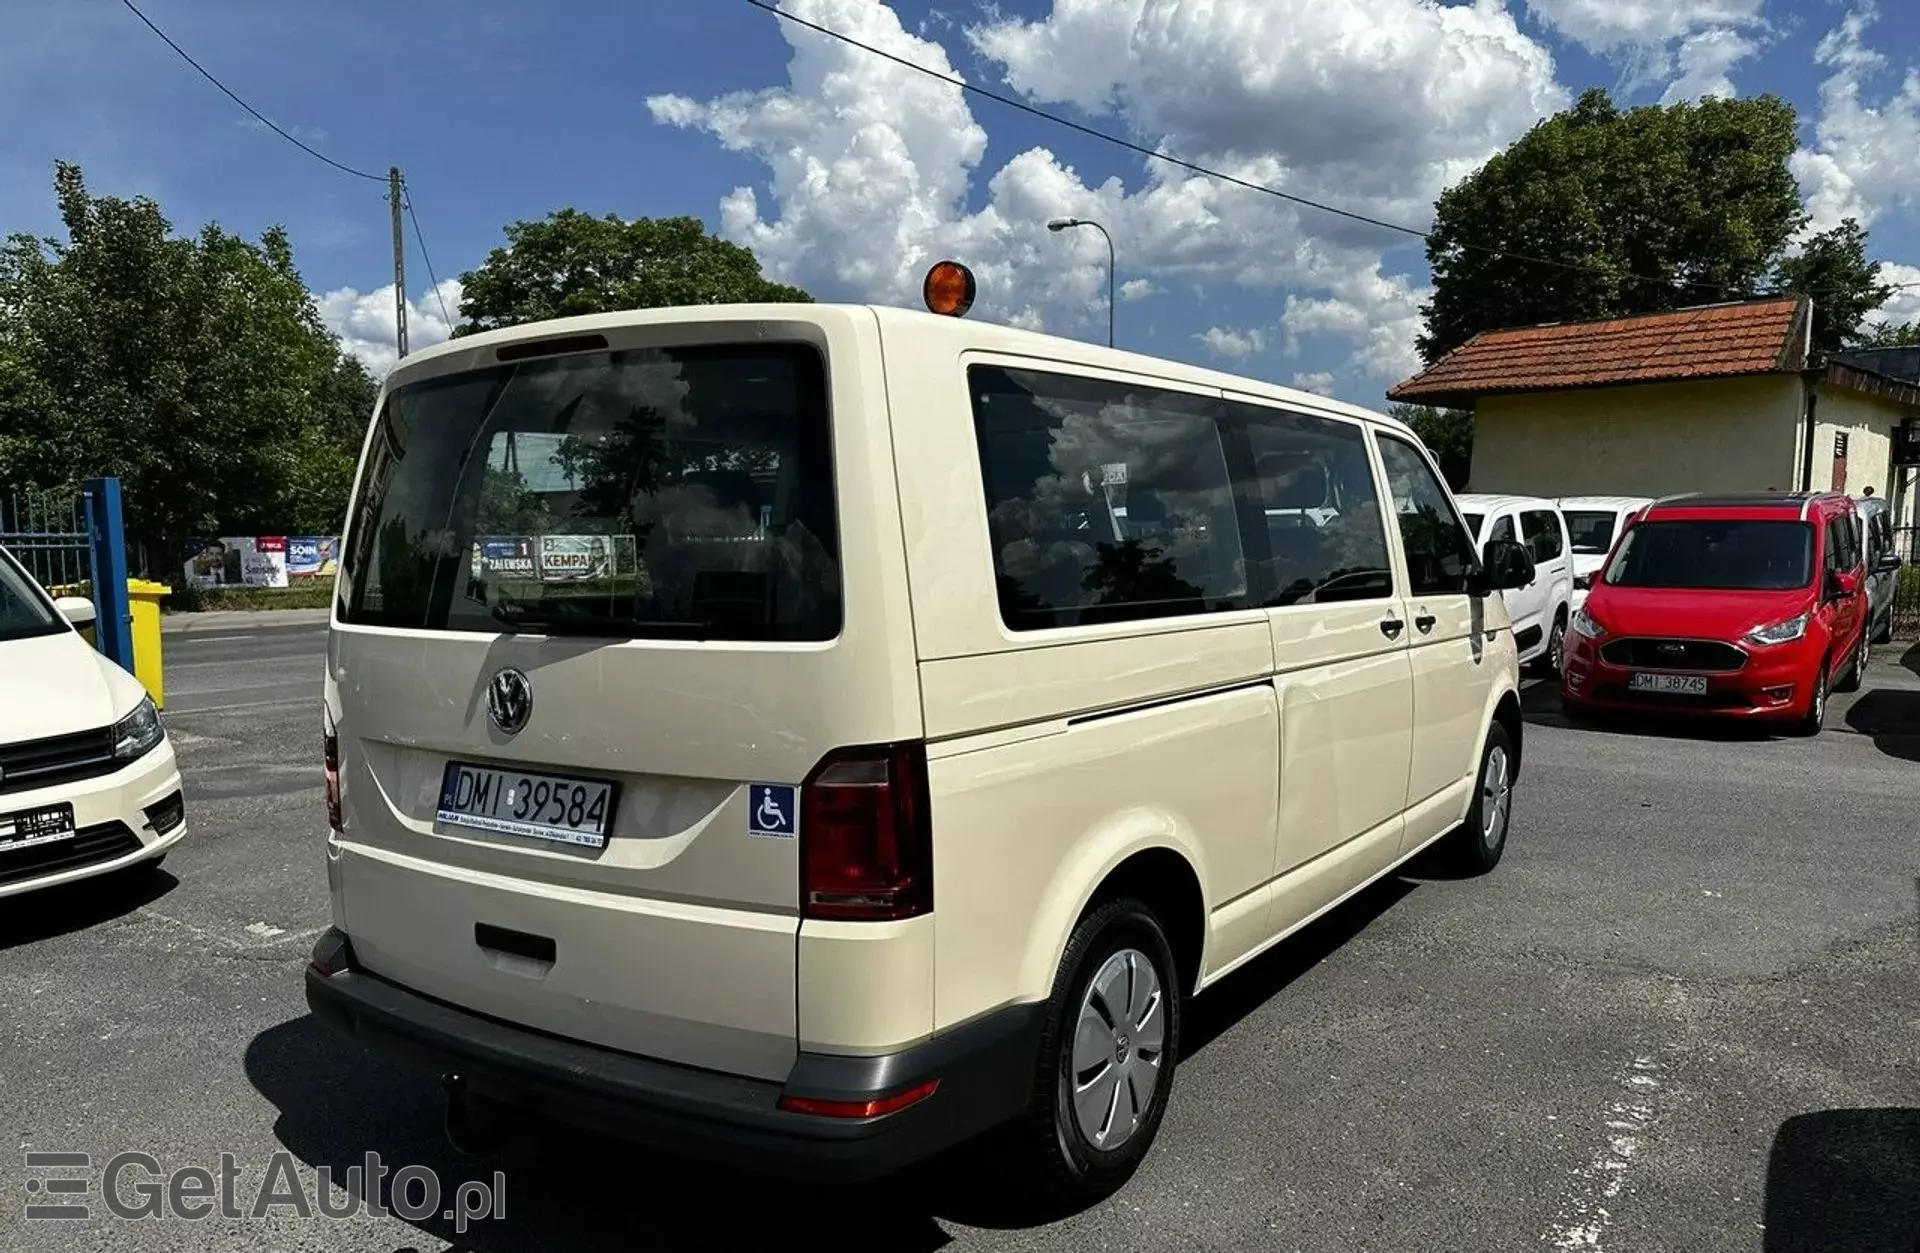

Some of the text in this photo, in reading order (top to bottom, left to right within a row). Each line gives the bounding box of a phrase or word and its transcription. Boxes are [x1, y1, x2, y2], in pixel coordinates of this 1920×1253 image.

[289, 545, 316, 555] SOIN
[1636, 675, 1705, 691] DMI 38745
[454, 769, 503, 816] DMI
[512, 777, 608, 833] 39584
